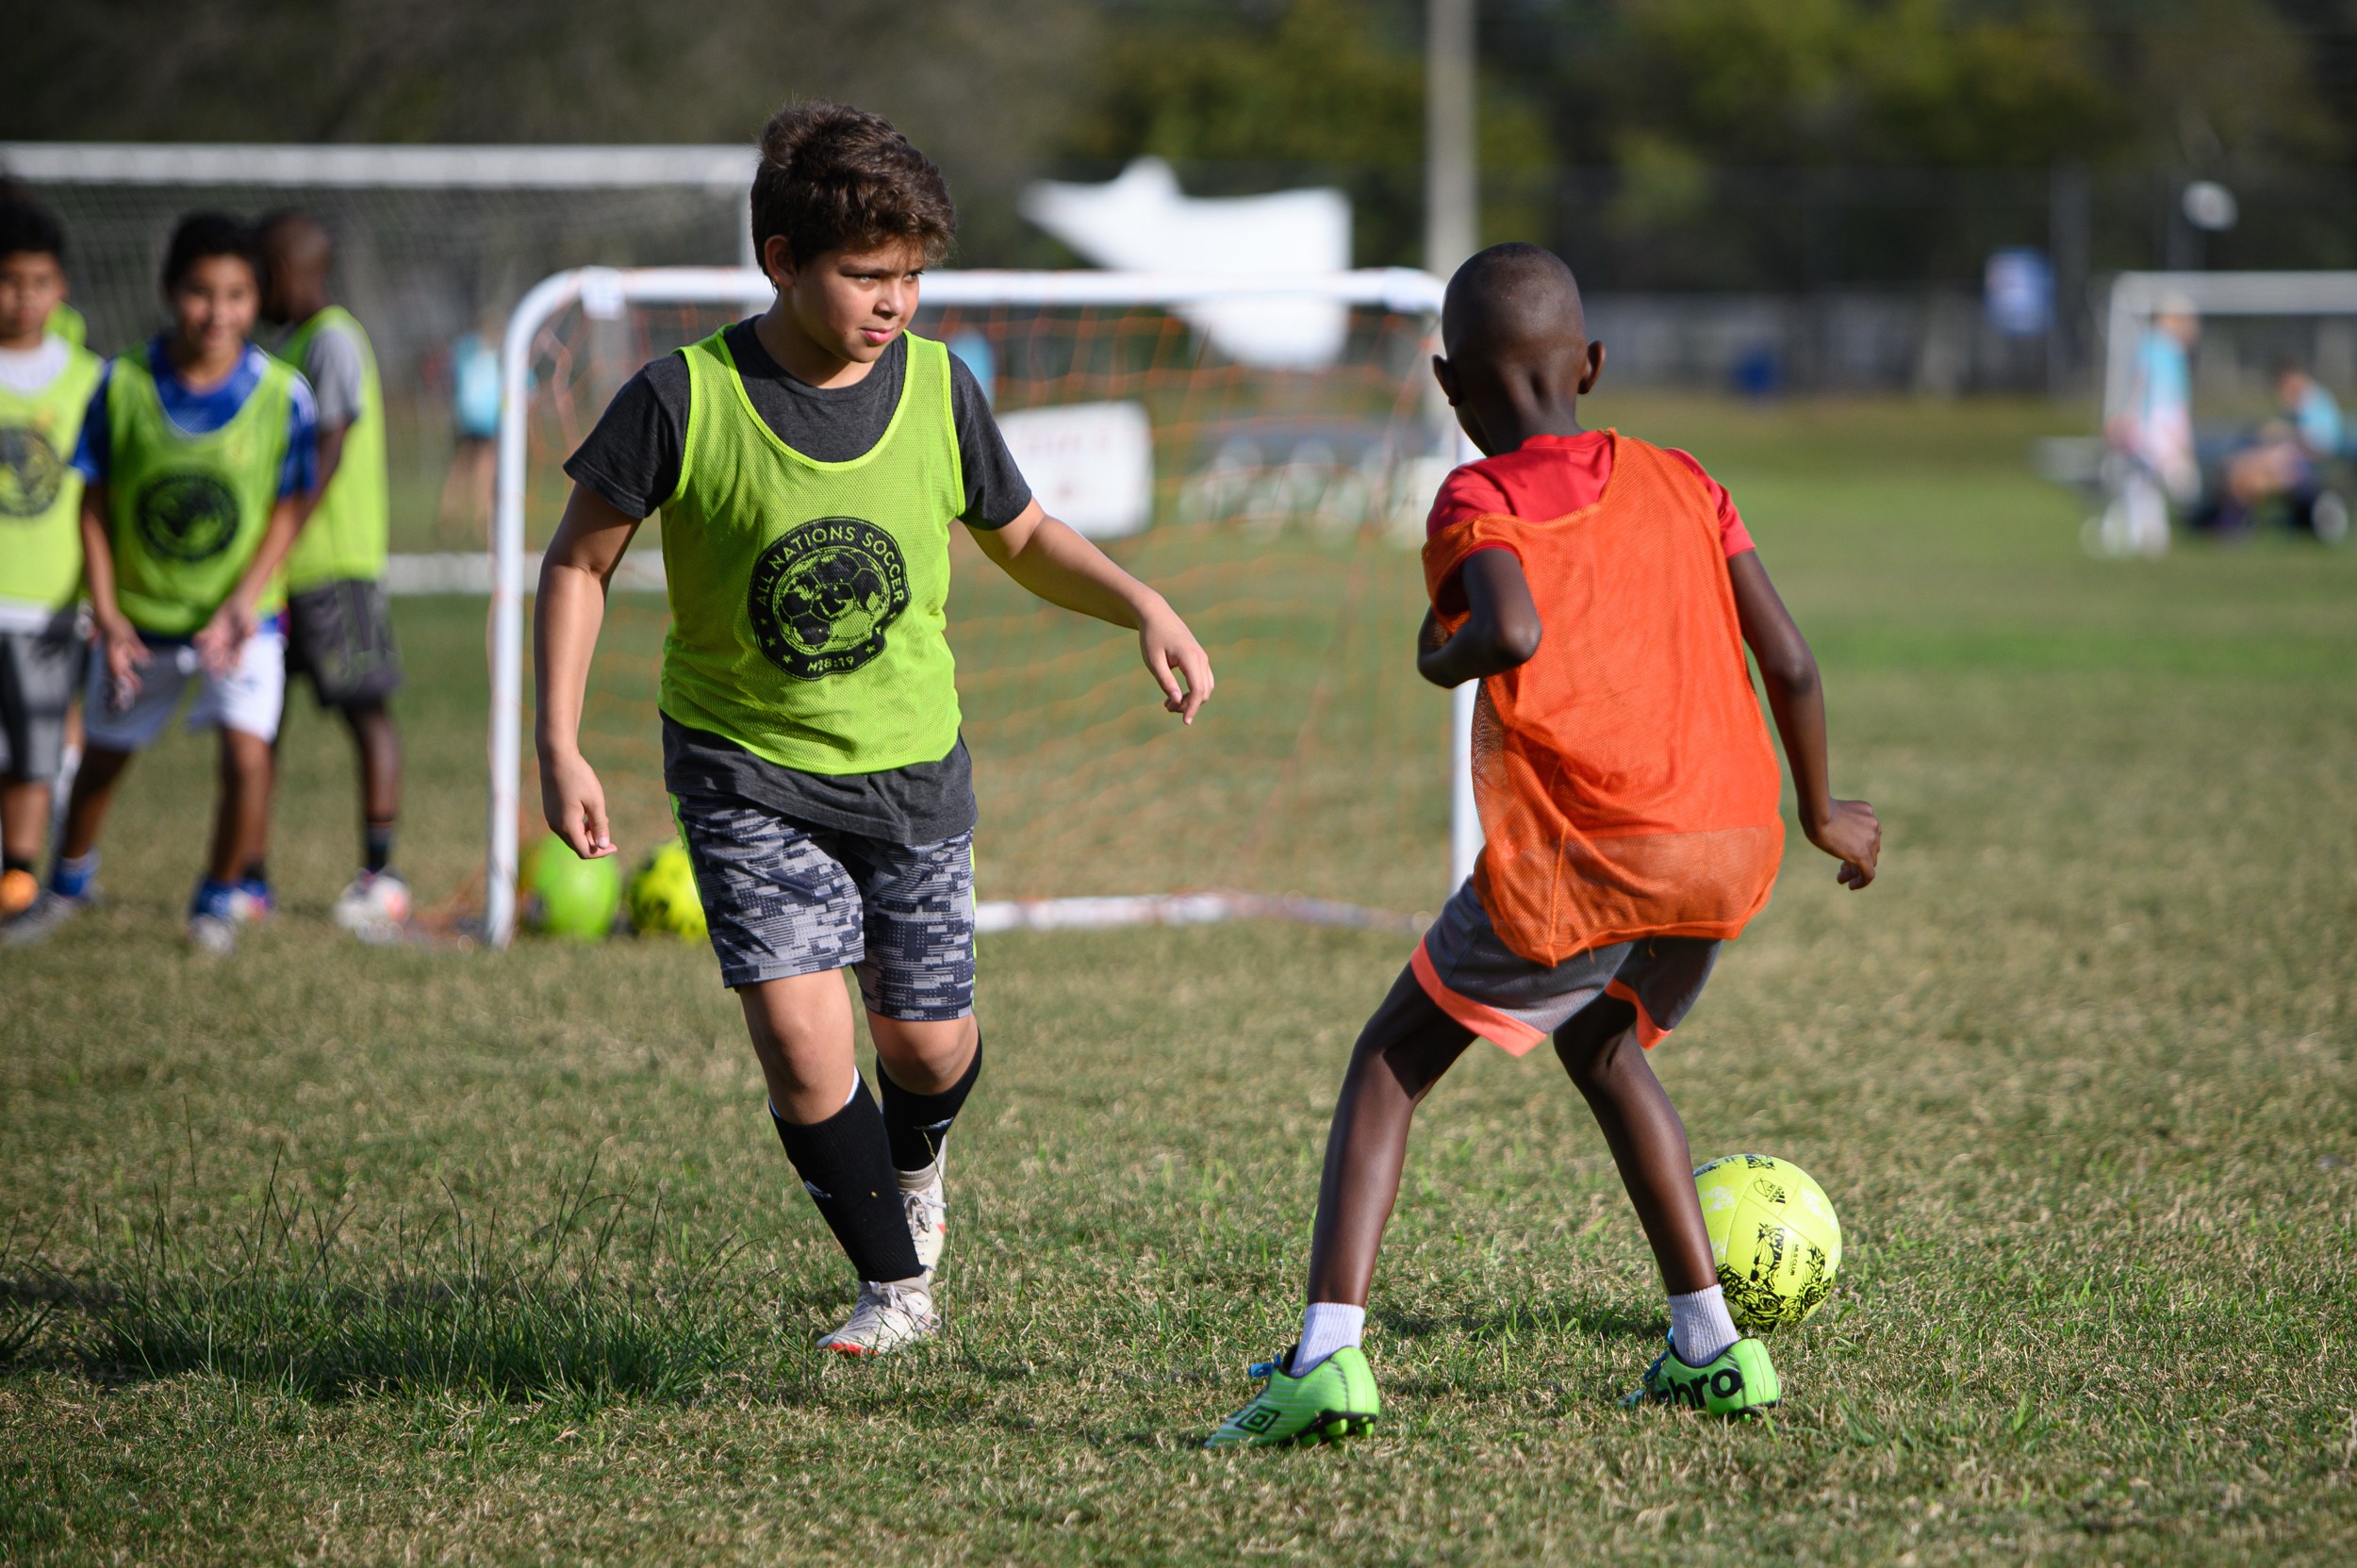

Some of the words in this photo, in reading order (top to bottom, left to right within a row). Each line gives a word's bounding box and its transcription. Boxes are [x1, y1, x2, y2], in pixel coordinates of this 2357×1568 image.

[754, 574, 775, 605] ALL
[768, 525, 856, 570] NATIONS
[862, 533, 905, 602] SOCCER
